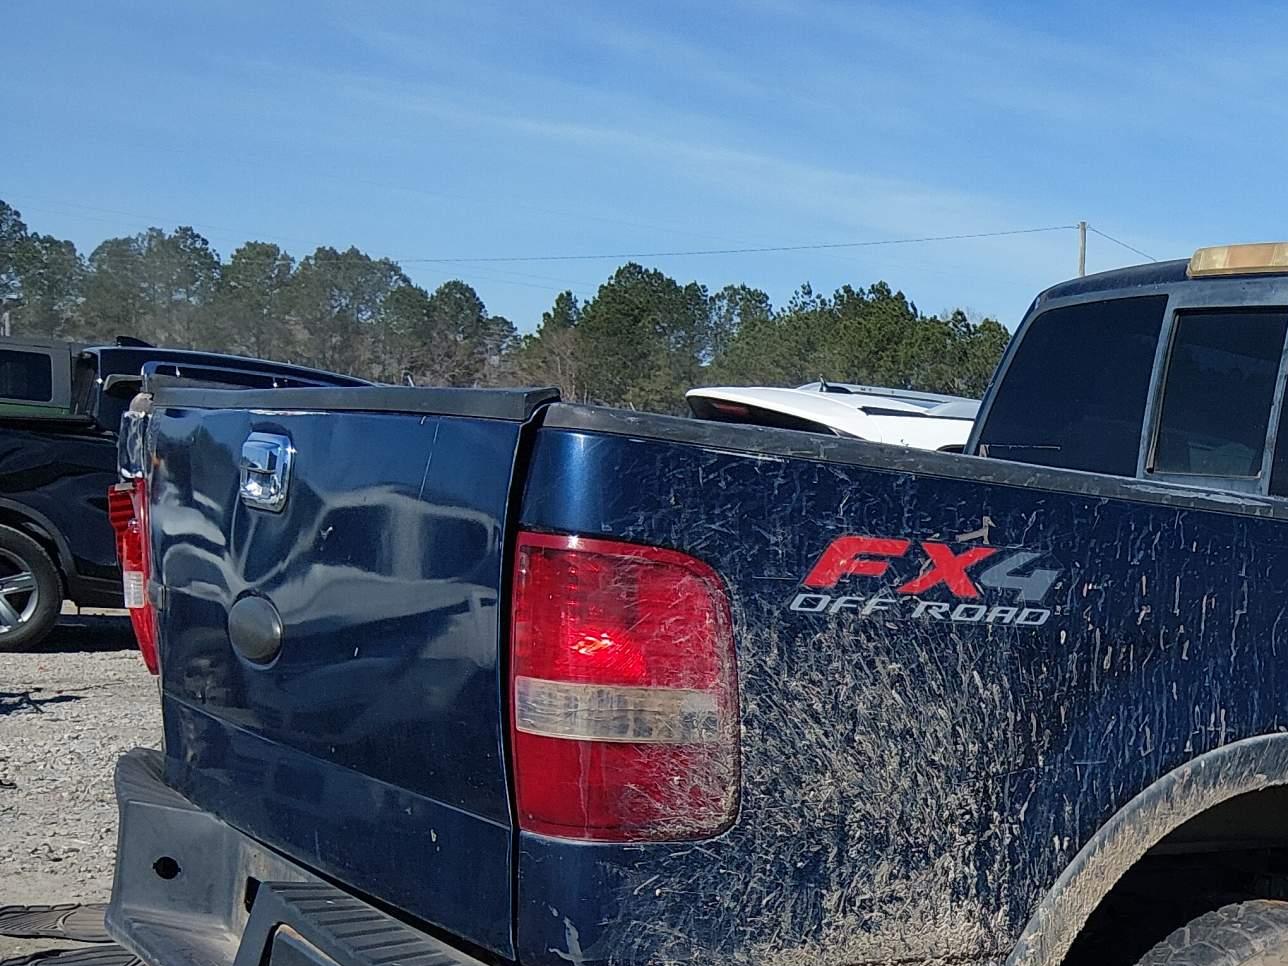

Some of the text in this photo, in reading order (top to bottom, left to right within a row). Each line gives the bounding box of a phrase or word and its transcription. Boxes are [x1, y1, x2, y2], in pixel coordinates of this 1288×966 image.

[800, 534, 1063, 602] FX4
[790, 593, 1051, 625] OFF ROAD
